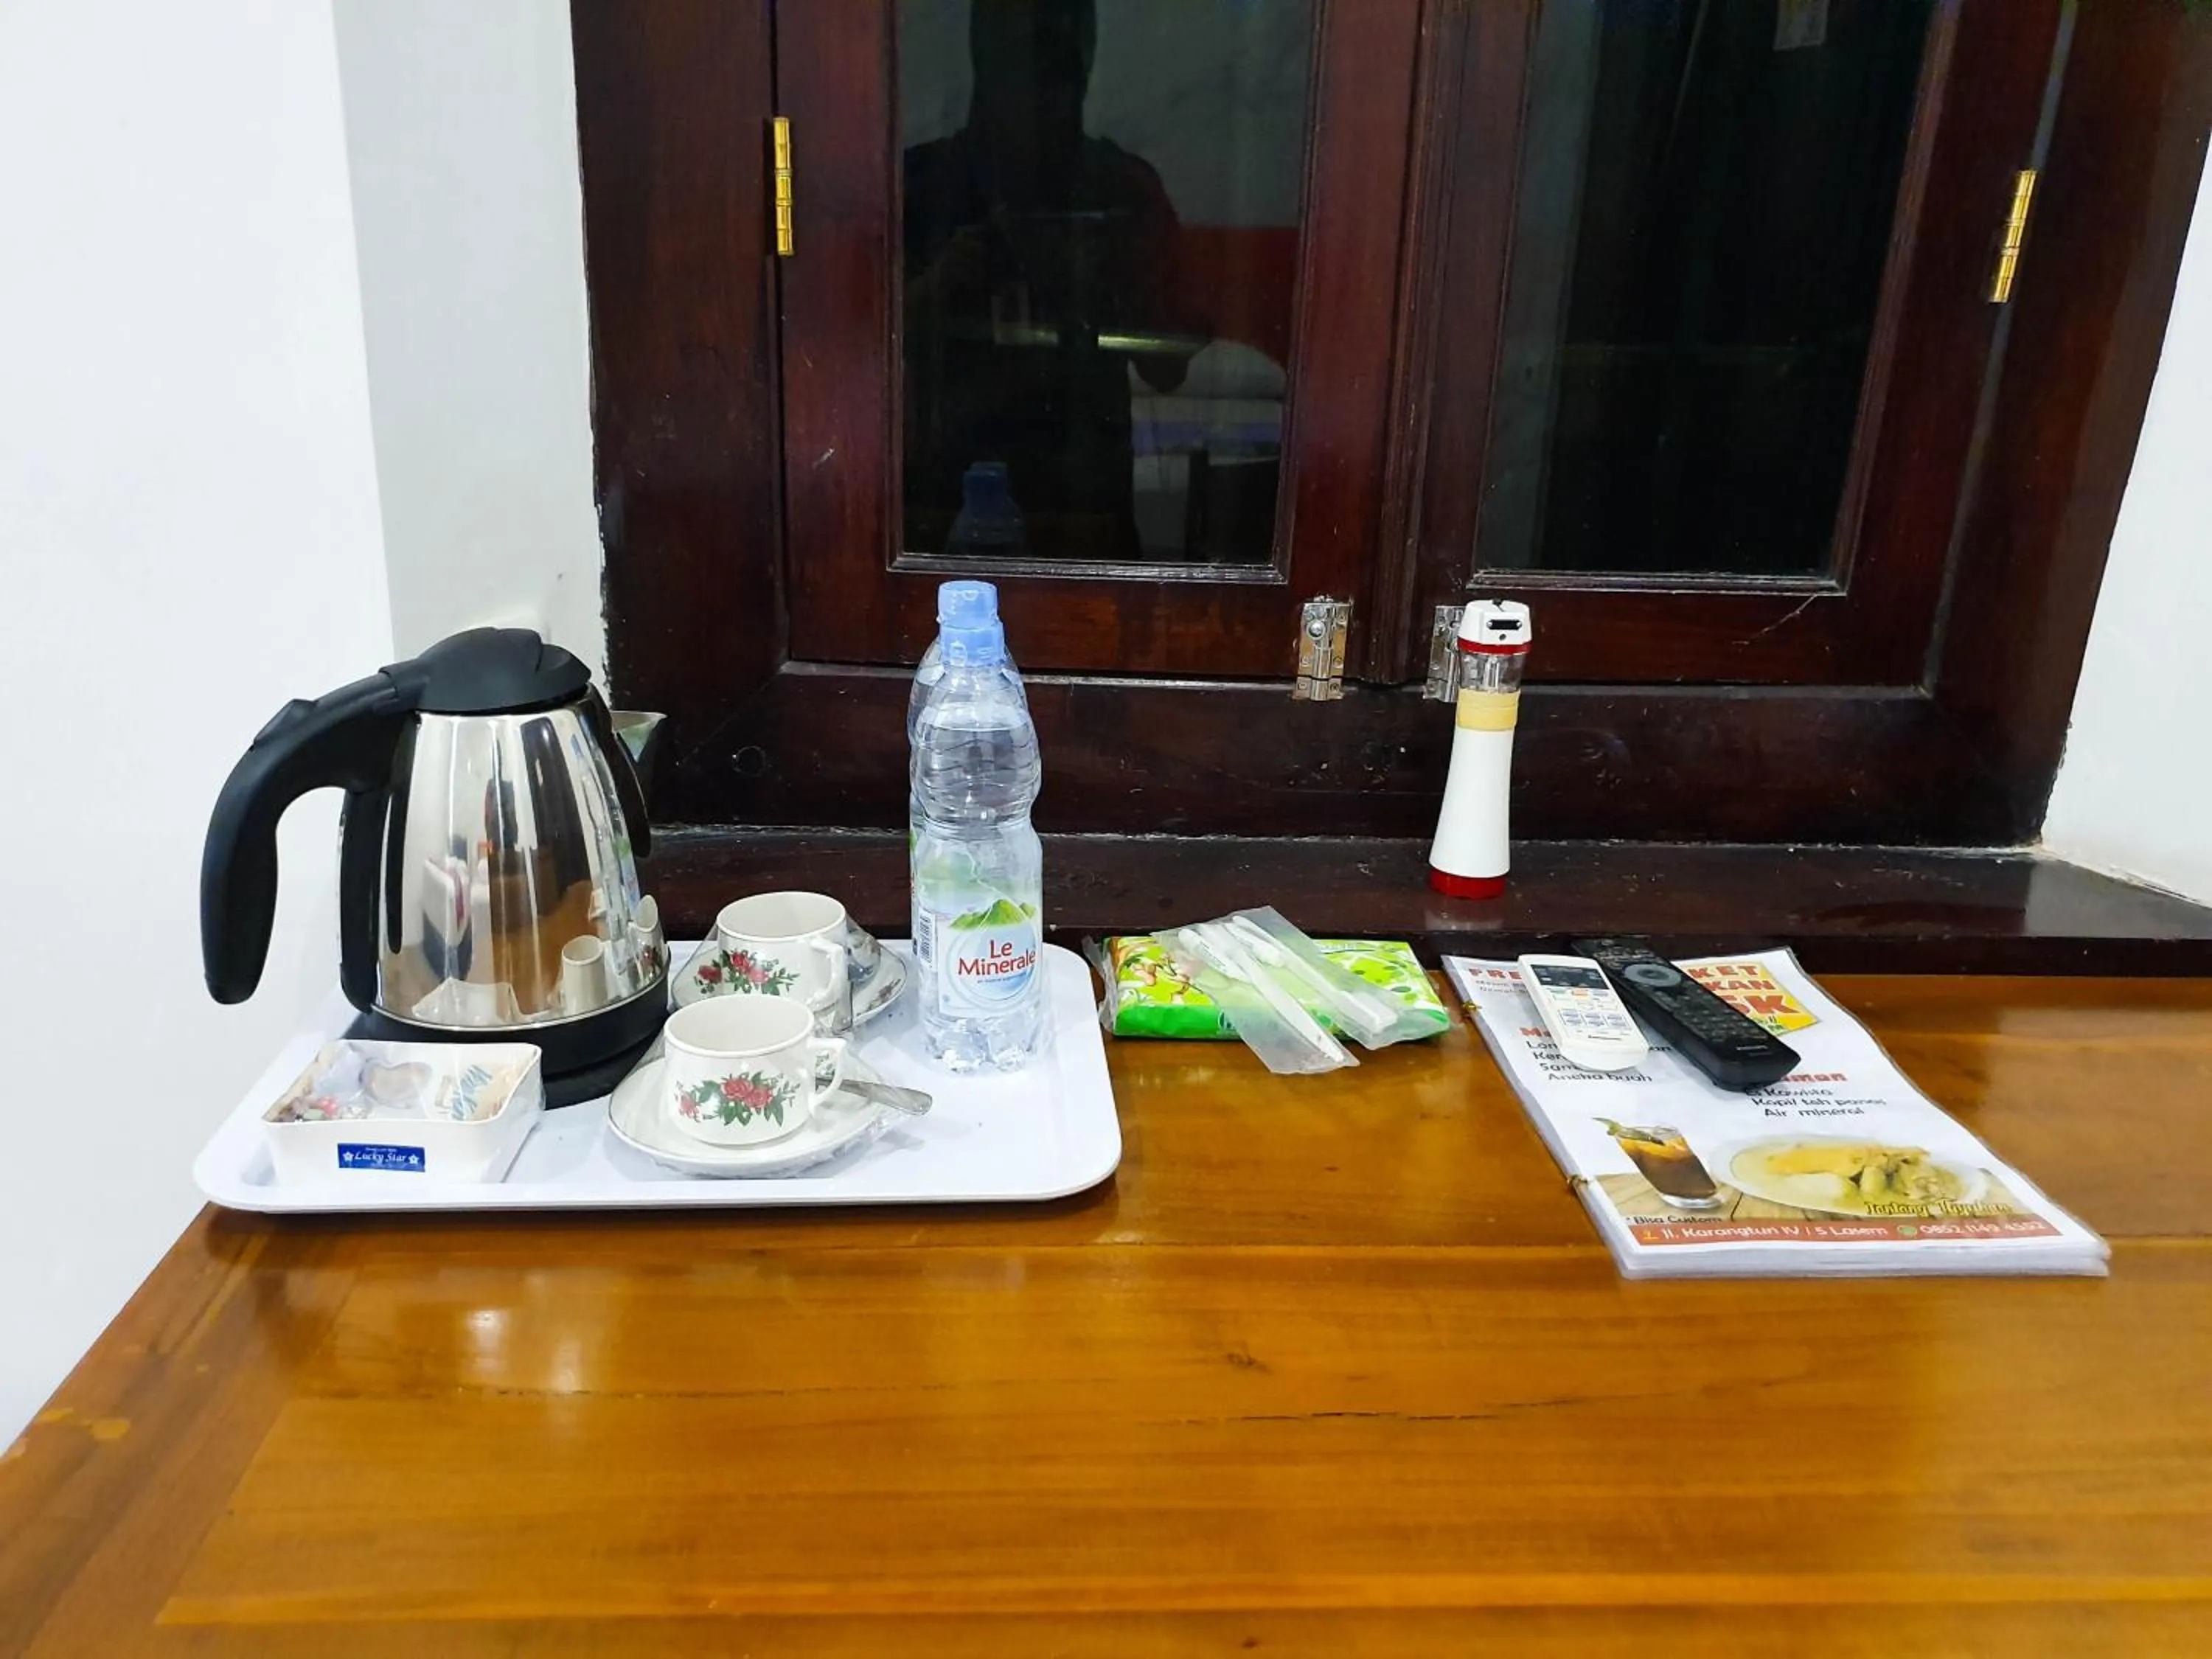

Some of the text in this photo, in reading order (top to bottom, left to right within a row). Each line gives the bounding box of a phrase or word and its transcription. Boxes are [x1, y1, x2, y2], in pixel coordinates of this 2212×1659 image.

[990, 939, 1012, 959] Le
[958, 948, 1036, 975] Minerale
[1687, 965, 1759, 978] KET
[1704, 980, 1776, 992] KAN
[1526, 1040, 1558, 1049] Lon
[1764, 1107, 1788, 1117] Air
[355, 1151, 407, 1164] Lucky Star
